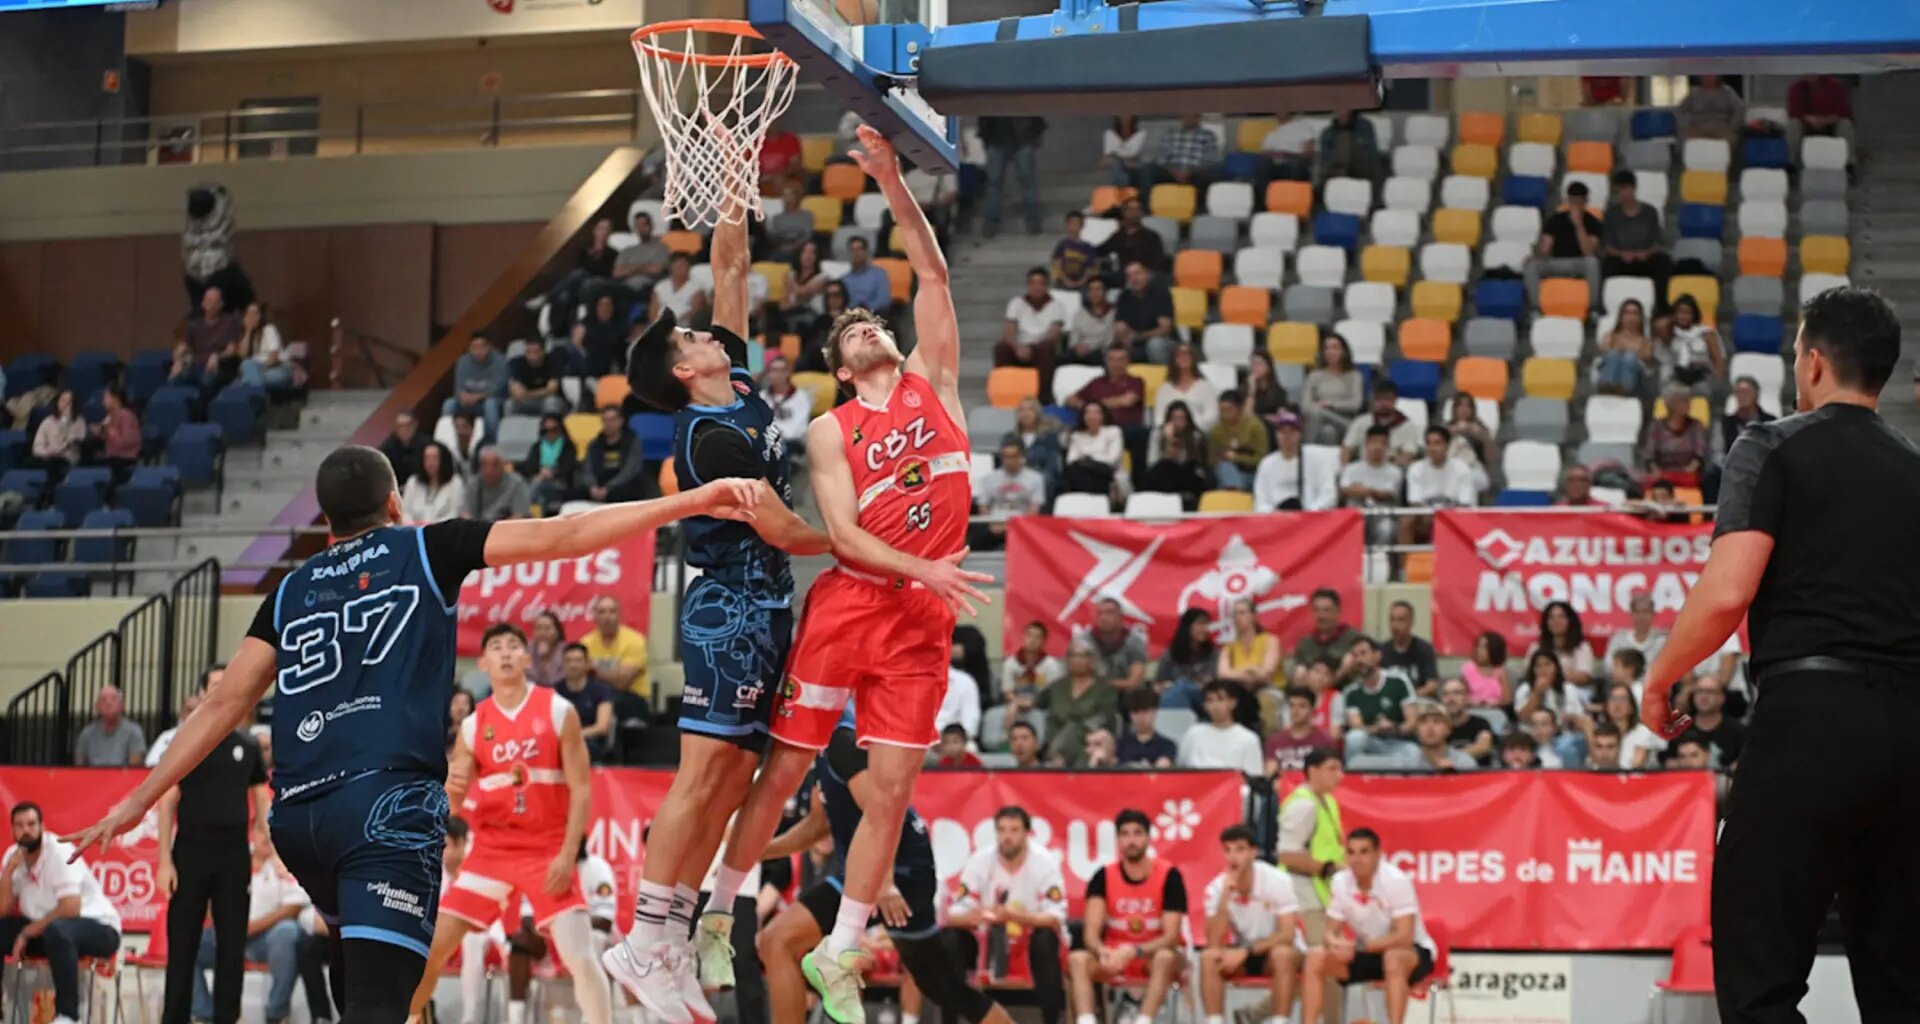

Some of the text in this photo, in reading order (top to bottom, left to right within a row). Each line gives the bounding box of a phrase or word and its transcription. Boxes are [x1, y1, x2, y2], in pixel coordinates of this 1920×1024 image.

[866, 416, 936, 472] CBZ
[906, 501, 931, 531] 55
[1523, 535, 1711, 566] AZULEJOS
[278, 585, 419, 695] 37
[492, 738, 539, 763] CBZ
[1517, 858, 1554, 882] de
[1567, 839, 1697, 884] MAINE
